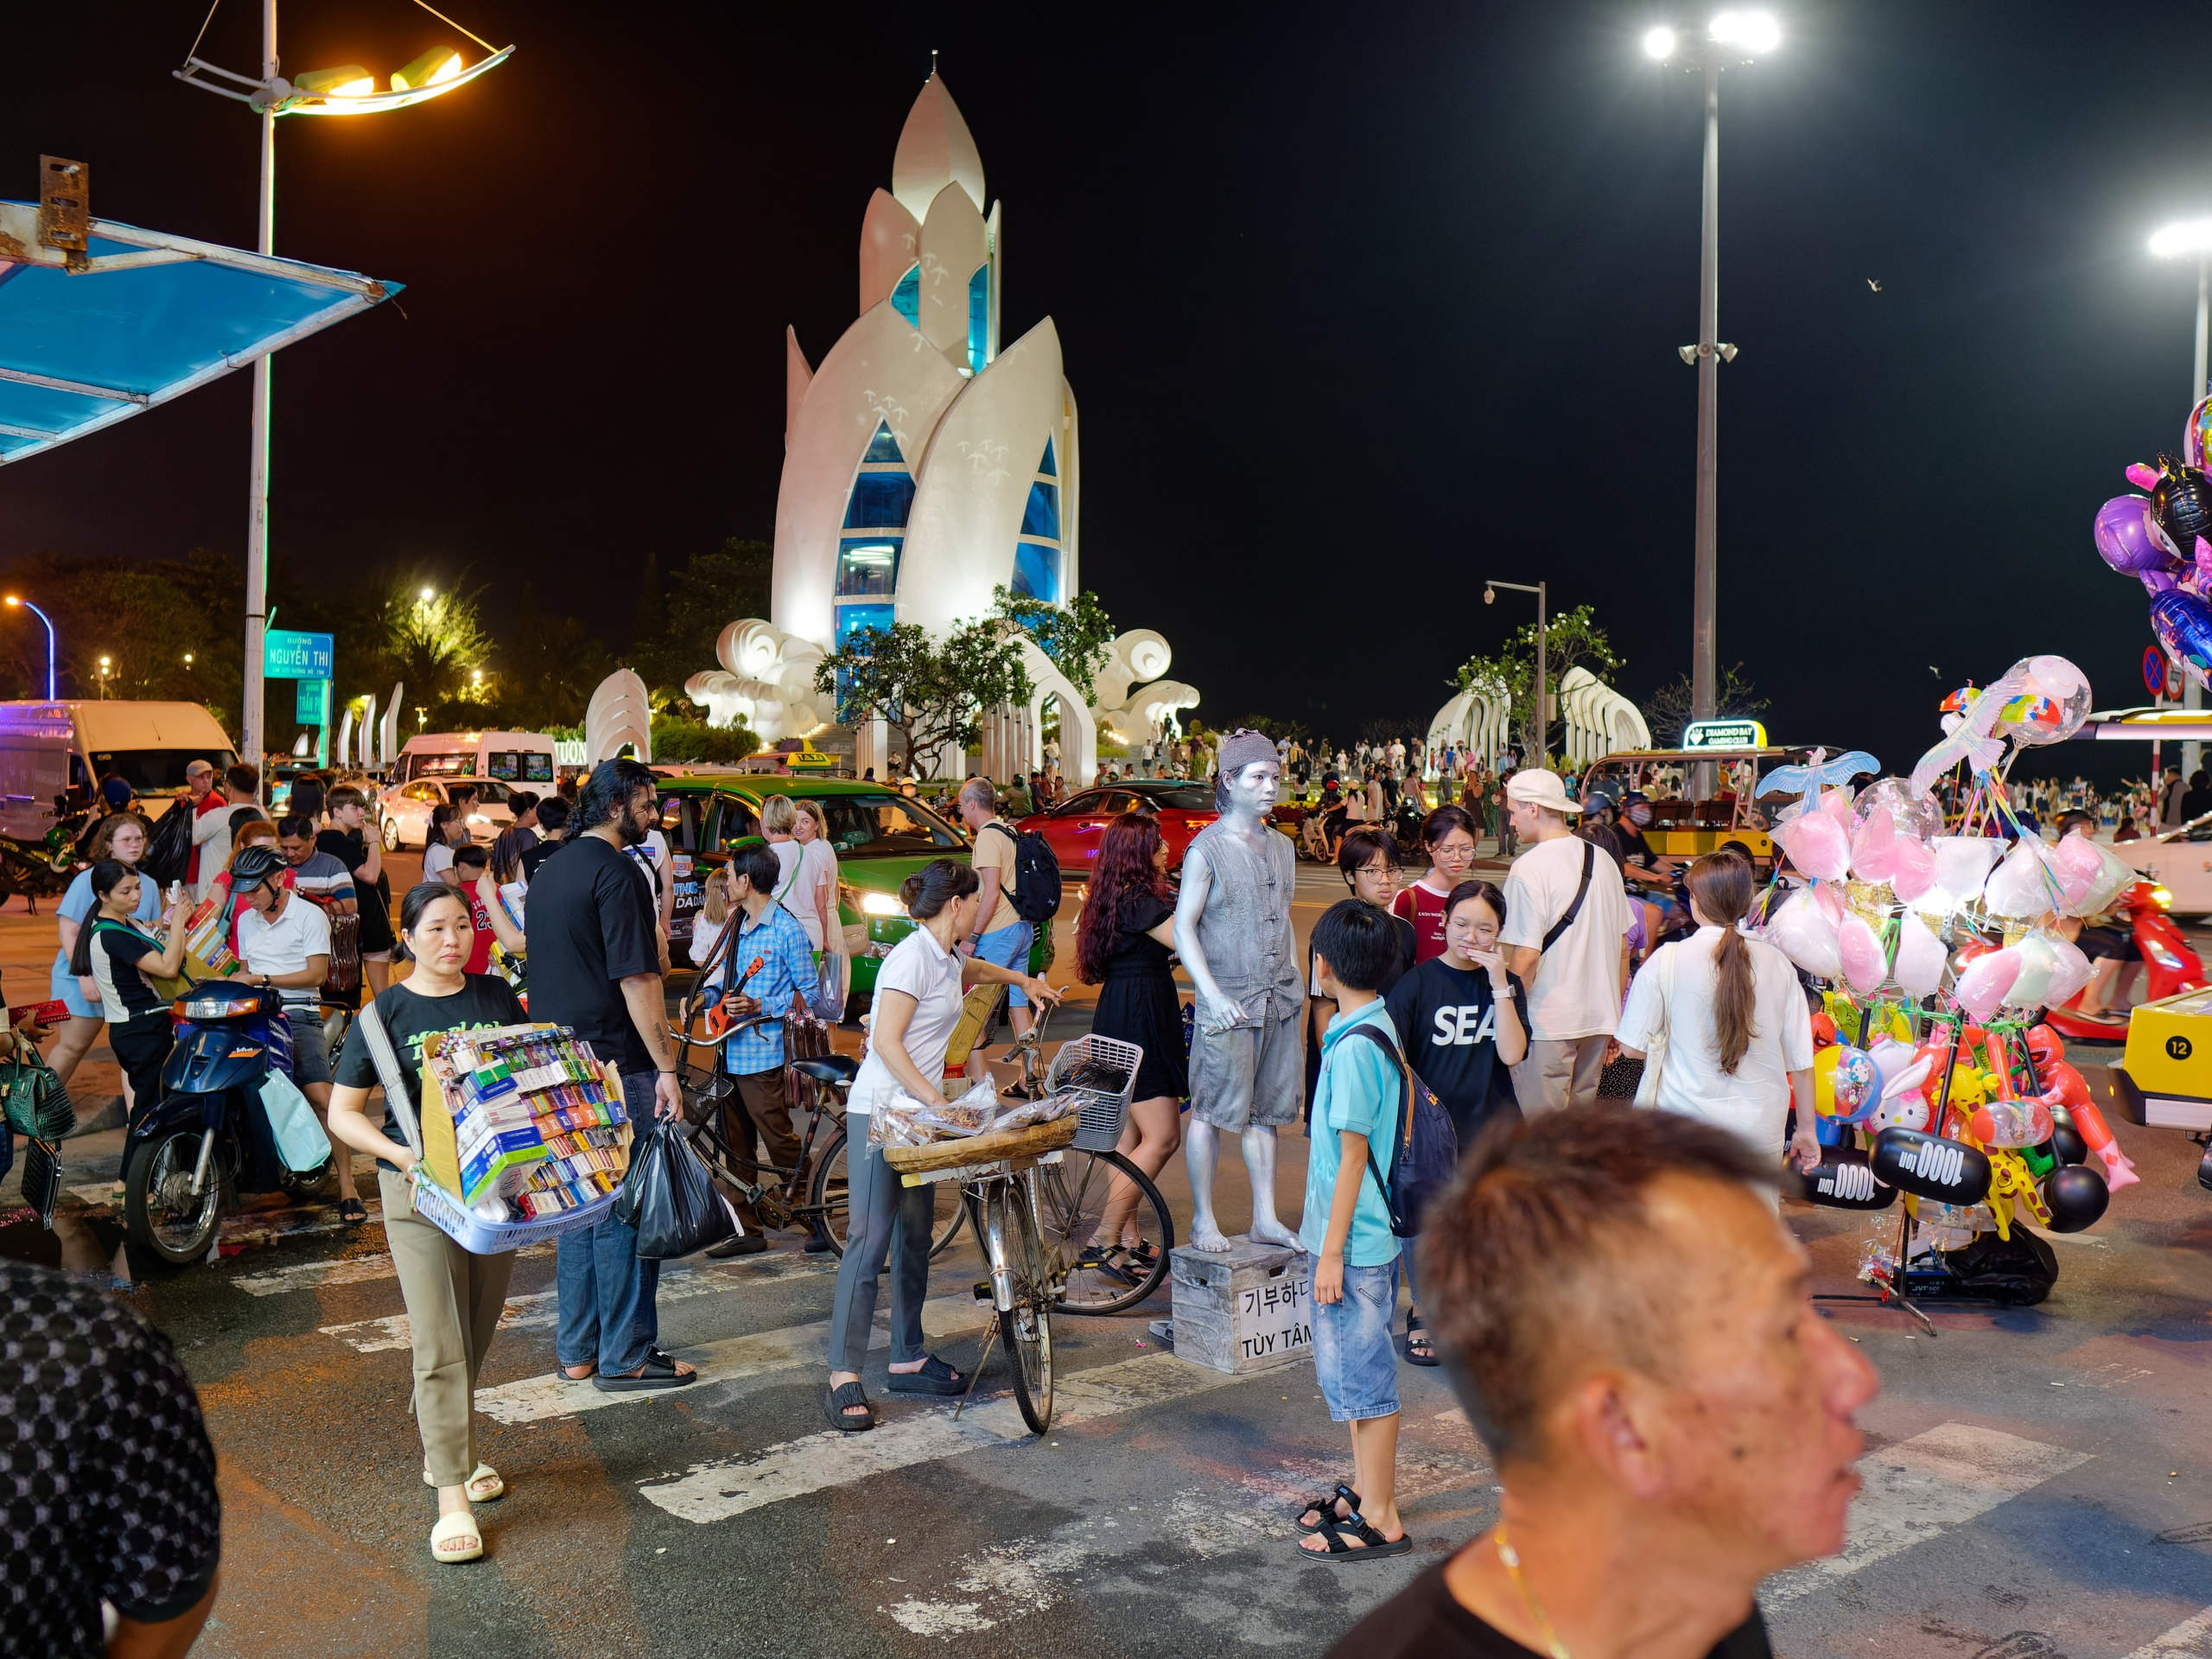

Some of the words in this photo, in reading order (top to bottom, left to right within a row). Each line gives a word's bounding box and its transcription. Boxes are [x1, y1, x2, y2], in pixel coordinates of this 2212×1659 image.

[1706, 728, 1738, 737] DIAMOND
[1739, 727, 1753, 736] BAY
[795, 753, 827, 762] TAXI
[1432, 1004, 1496, 1046] SEA
[2171, 1040, 2187, 1055] 12
[1898, 1151, 1917, 1173] ton
[1916, 1141, 1965, 1187] 1000
[1817, 1177, 1834, 1195] ton
[1834, 1163, 1875, 1202] 1000
[1242, 1332, 1275, 1358] TÙY
